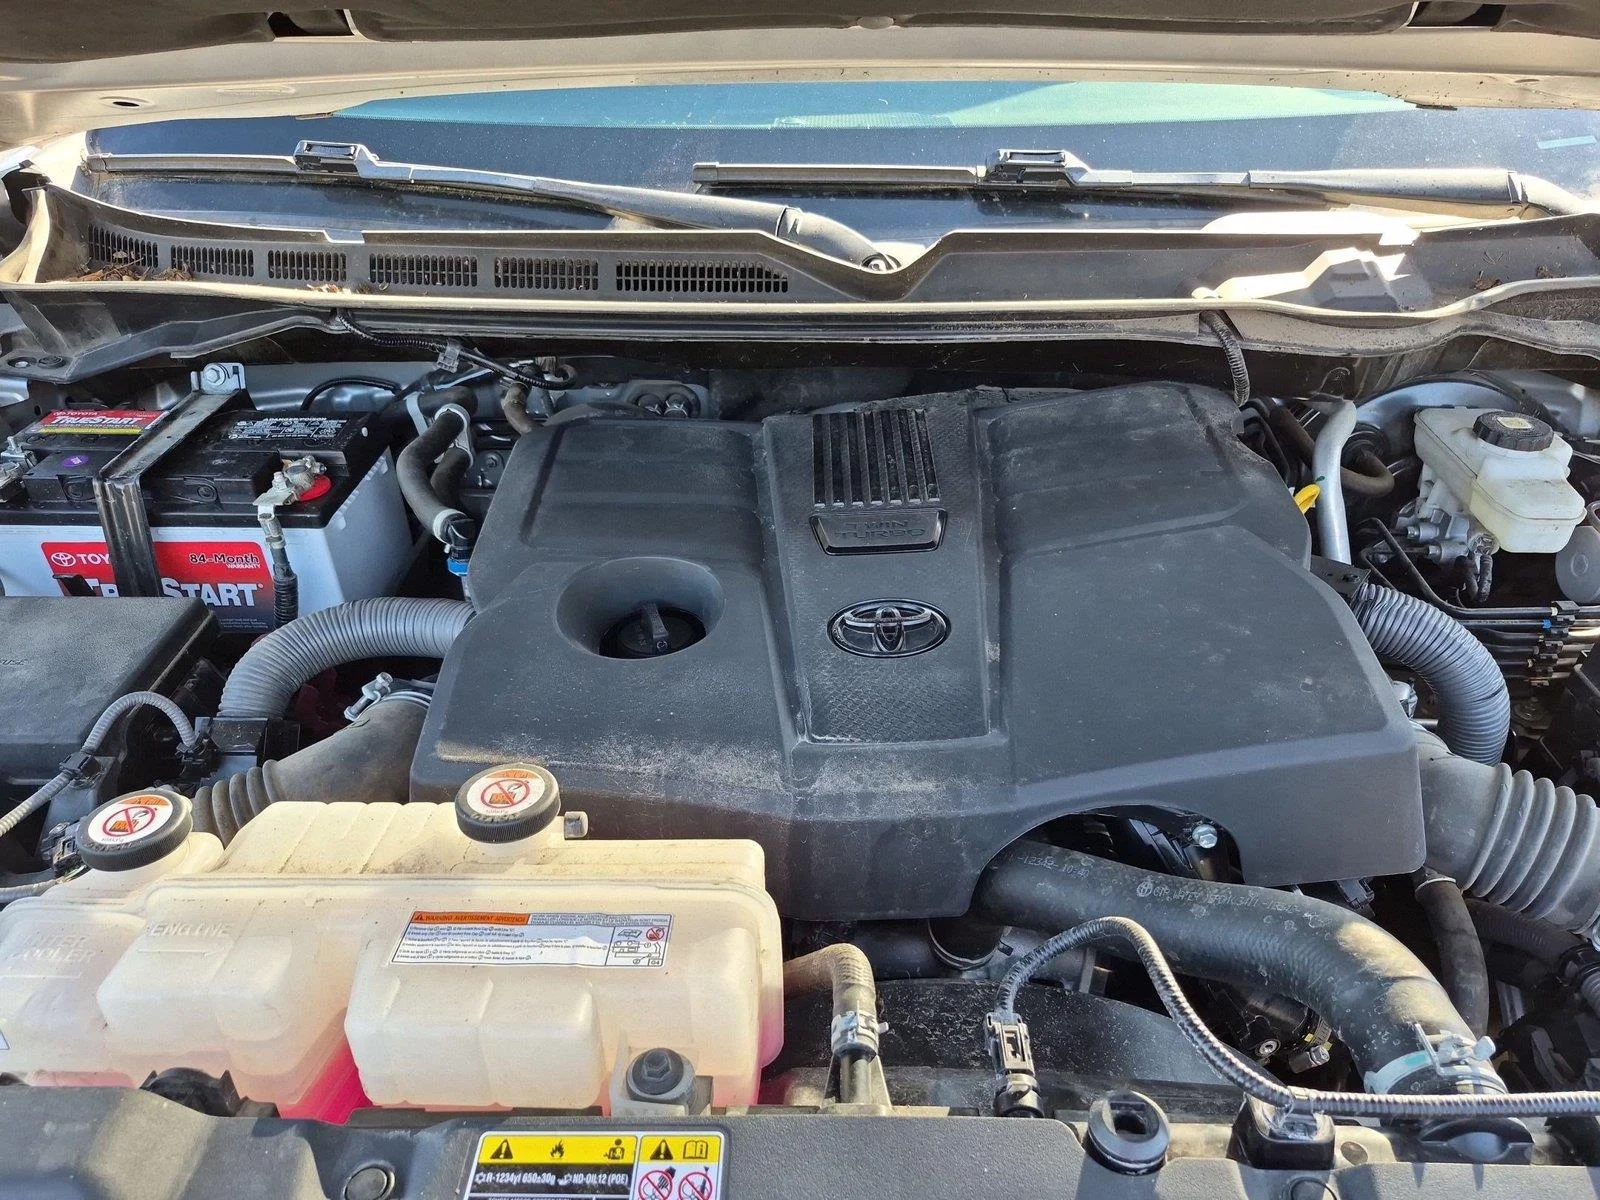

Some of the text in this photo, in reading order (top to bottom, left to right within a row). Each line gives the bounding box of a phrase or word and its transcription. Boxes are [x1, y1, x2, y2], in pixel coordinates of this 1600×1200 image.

[76, 553, 112, 565] TOY
[189, 552, 260, 564] 84-Month
[150, 922, 233, 937] ENGINE
